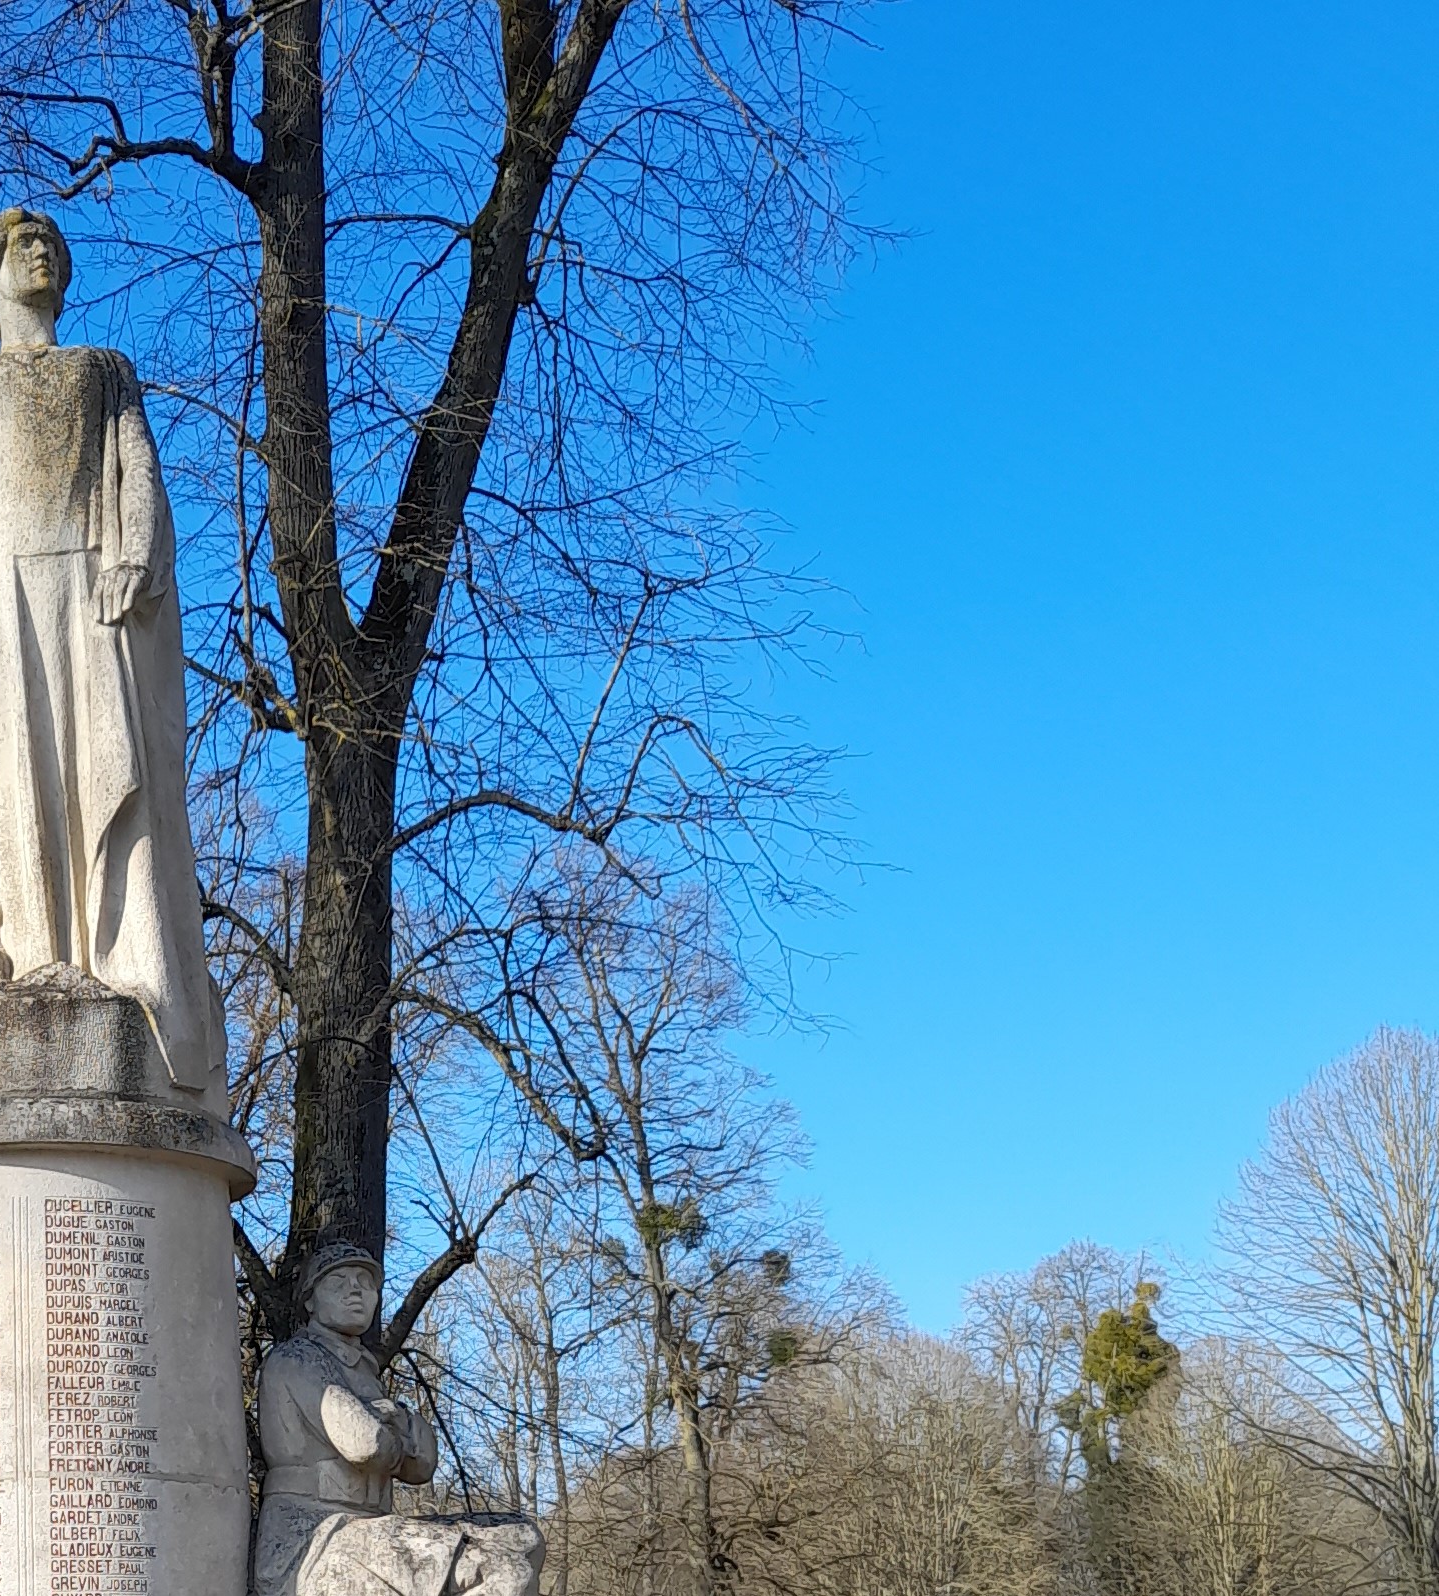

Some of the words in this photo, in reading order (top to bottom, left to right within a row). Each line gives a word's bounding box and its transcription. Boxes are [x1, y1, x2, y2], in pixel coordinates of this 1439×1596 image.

[45, 1199, 112, 1213] DUCELLIER
[121, 1205, 155, 1218] EUGENE
[45, 1215, 88, 1228] DUGUE
[95, 1219, 133, 1231] GASTON
[46, 1231, 99, 1245] DUMENIL
[107, 1235, 144, 1247] GASTON
[46, 1247, 97, 1260] DUMONT
[46, 1263, 98, 1277] DUMONT
[106, 1267, 149, 1279] GEORGES
[46, 1279, 85, 1292] DUPAS
[95, 1282, 128, 1294] VICTOR
[47, 1295, 92, 1309] DUPUIS
[100, 1299, 139, 1311] MARCEL
[47, 1312, 99, 1326] DURAND
[106, 1315, 144, 1328] ALBERT
[47, 1328, 99, 1341] DURAND
[106, 1332, 149, 1344] ANATOLE
[47, 1344, 99, 1357] DURAND
[107, 1347, 133, 1360] LEON
[47, 1360, 107, 1373] DUROZOY
[114, 1364, 156, 1376] GEORGES
[48, 1376, 104, 1390] FALLEUR
[48, 1393, 90, 1406] FEREZ
[98, 1396, 135, 1407] ROBERT
[49, 1409, 99, 1422] FETROP
[49, 1425, 102, 1439] FORTIER
[109, 1428, 157, 1440] ALPHONSE
[49, 1441, 102, 1455] FORTIER
[110, 1443, 149, 1457] GASTON
[49, 1459, 113, 1472] FRETIGNY
[117, 1461, 150, 1473] ANDRE
[50, 1478, 93, 1491] FURON
[50, 1494, 112, 1508] GAILLARD
[119, 1497, 157, 1509] EDMOND
[50, 1511, 102, 1524] GARDET
[108, 1514, 139, 1524] ANDRE
[50, 1527, 106, 1540] GILBERT
[113, 1529, 140, 1542] FELIX
[51, 1543, 113, 1556] GLADIEUX
[121, 1546, 156, 1557] EUGENE
[51, 1560, 112, 1574] GRESSET
[119, 1562, 144, 1574] PAUL
[52, 1577, 99, 1590] GREVIN
[107, 1580, 147, 1592] JOSEPH
